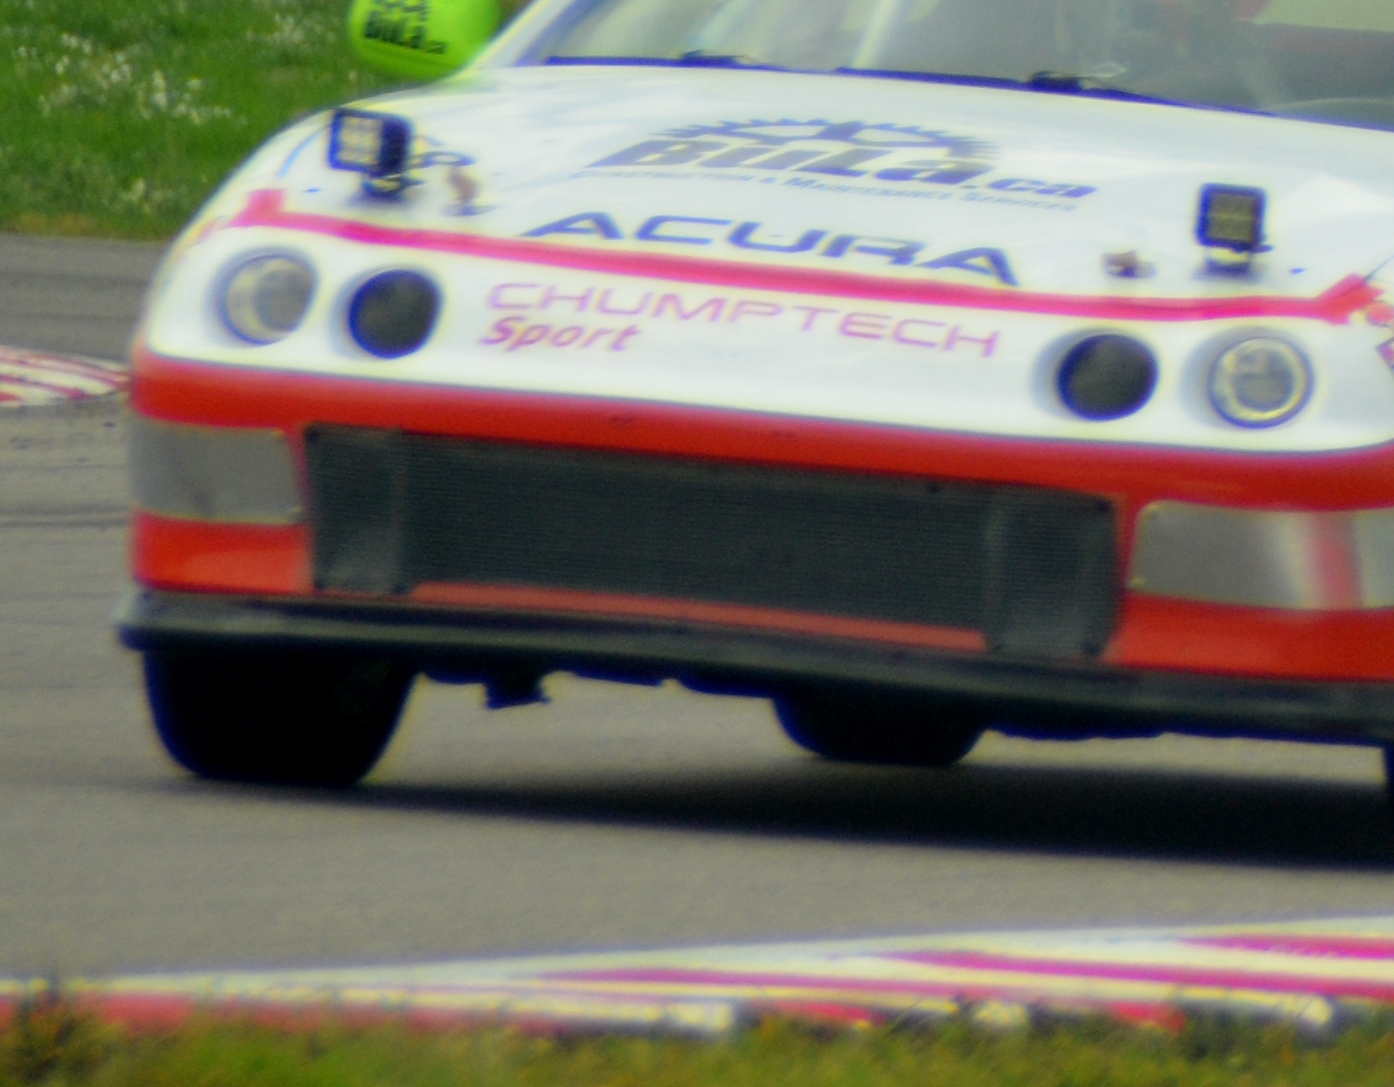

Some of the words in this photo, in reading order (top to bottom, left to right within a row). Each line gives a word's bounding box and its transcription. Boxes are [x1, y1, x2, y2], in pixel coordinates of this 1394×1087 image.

[587, 139, 1099, 199] BuLa.ca
[521, 211, 1021, 287] ACURA
[480, 314, 643, 353] Sport
[484, 281, 1000, 358] CHUMPTECH
